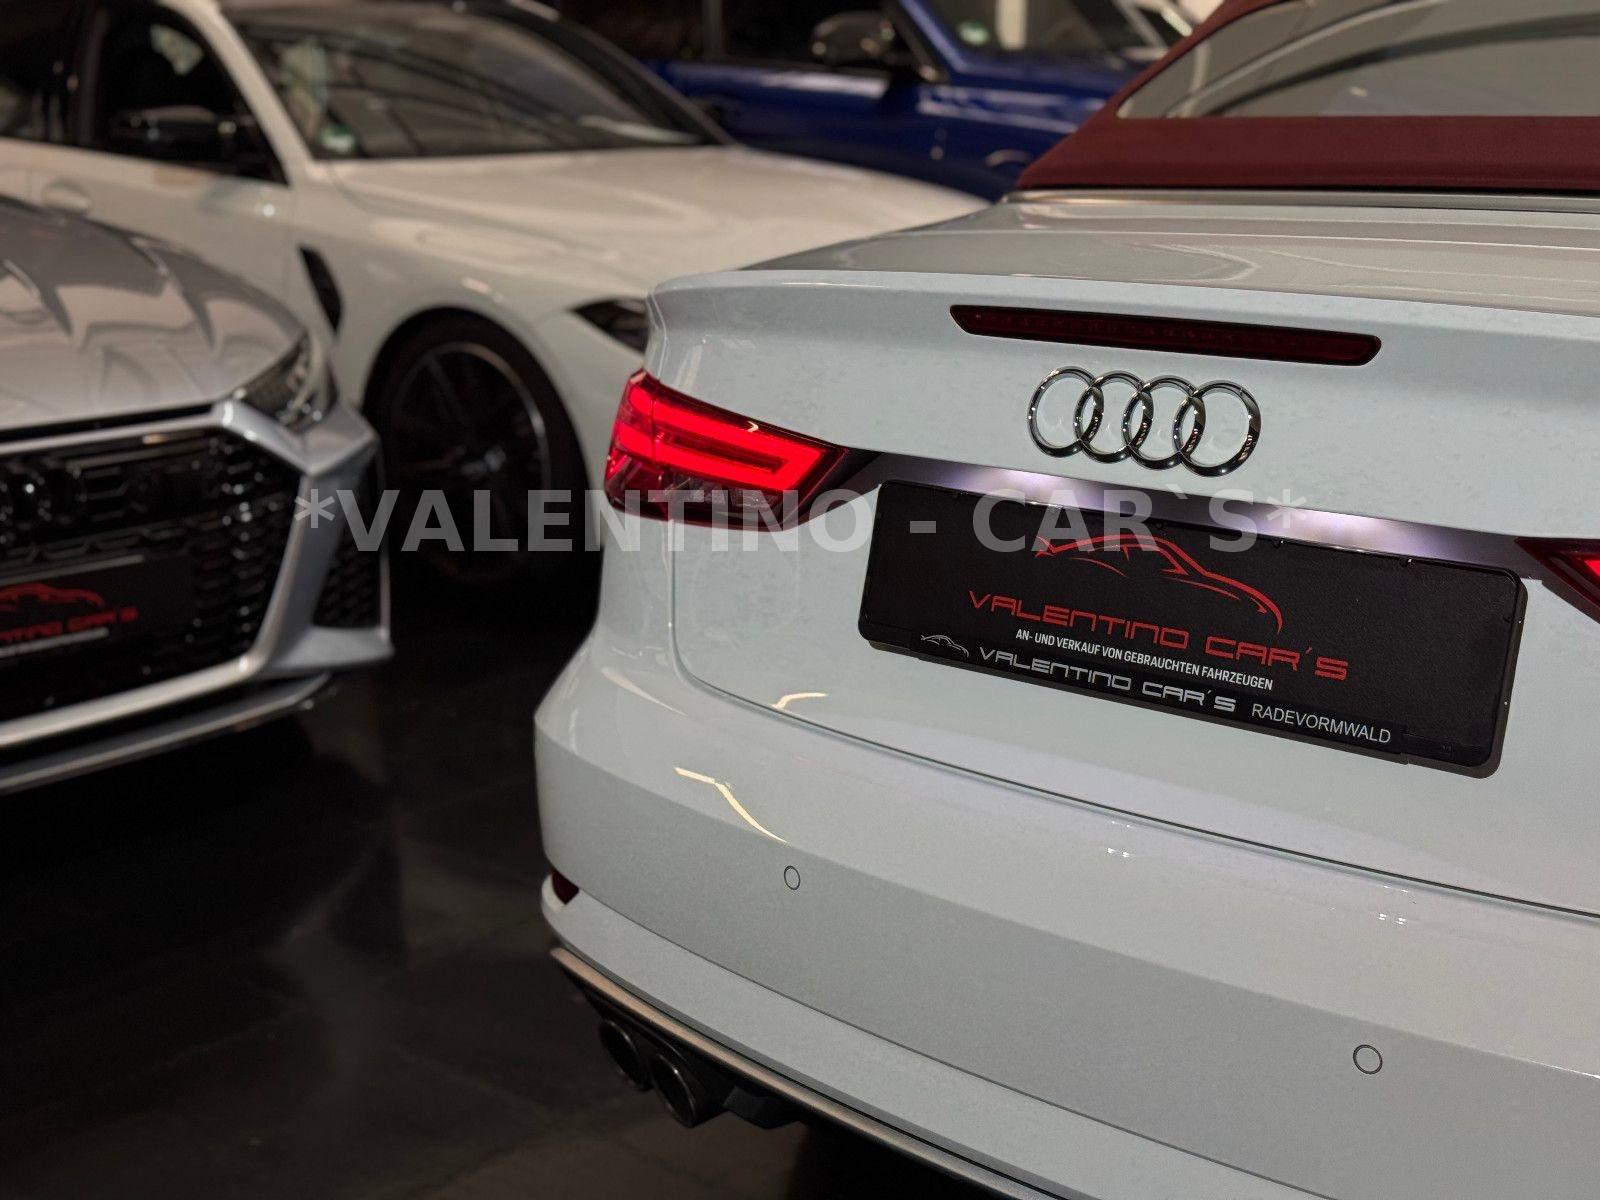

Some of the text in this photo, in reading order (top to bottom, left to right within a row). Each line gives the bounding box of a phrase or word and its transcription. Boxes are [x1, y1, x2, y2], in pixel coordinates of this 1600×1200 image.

[968, 590, 1190, 650] VALENTINO
[1015, 628, 1274, 691] AN- UND VERKAUF VON GEBRAUCHTEN FAHRZEUGEN
[979, 646, 1132, 692] VALENTINO
[1252, 703, 1392, 745] RADEVORMWALD
